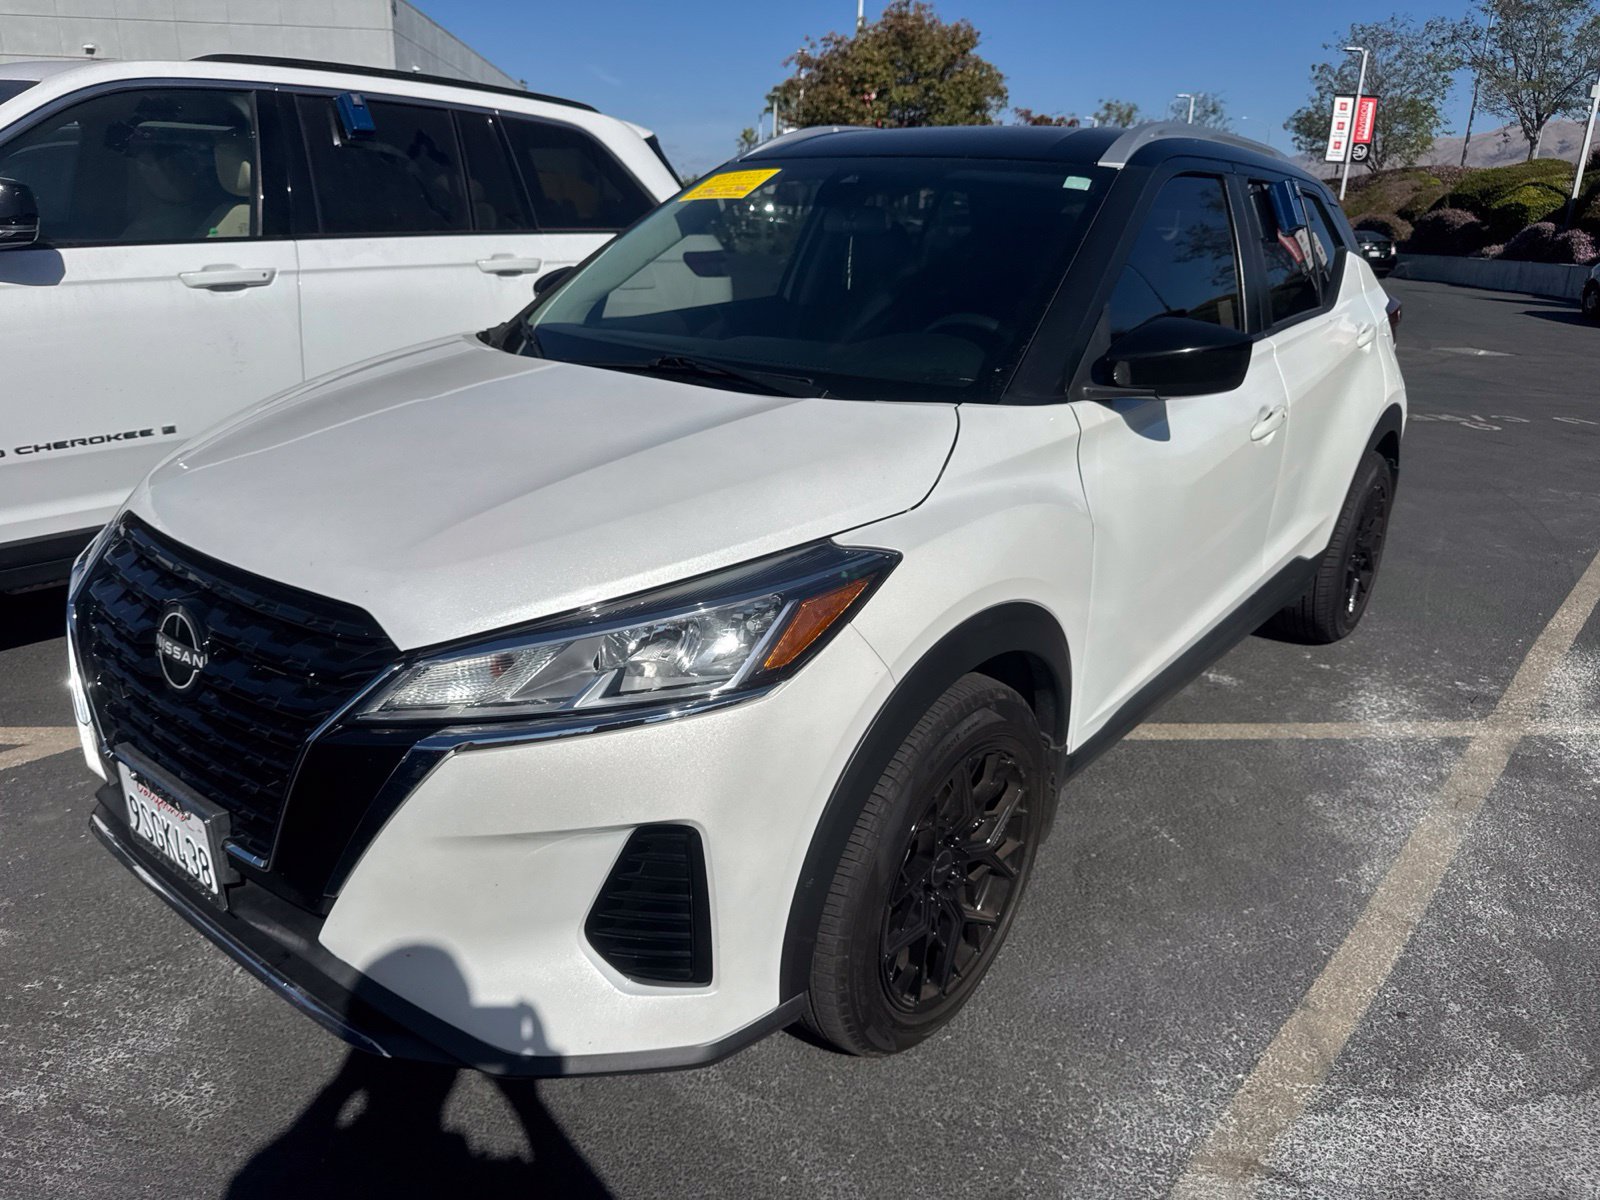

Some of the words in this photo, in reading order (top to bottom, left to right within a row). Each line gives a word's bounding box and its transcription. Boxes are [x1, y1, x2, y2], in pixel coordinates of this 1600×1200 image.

[14, 428, 155, 455] CHEROKEE
[156, 632, 204, 669] NISSAN
[128, 794, 214, 890] 9SGK438
